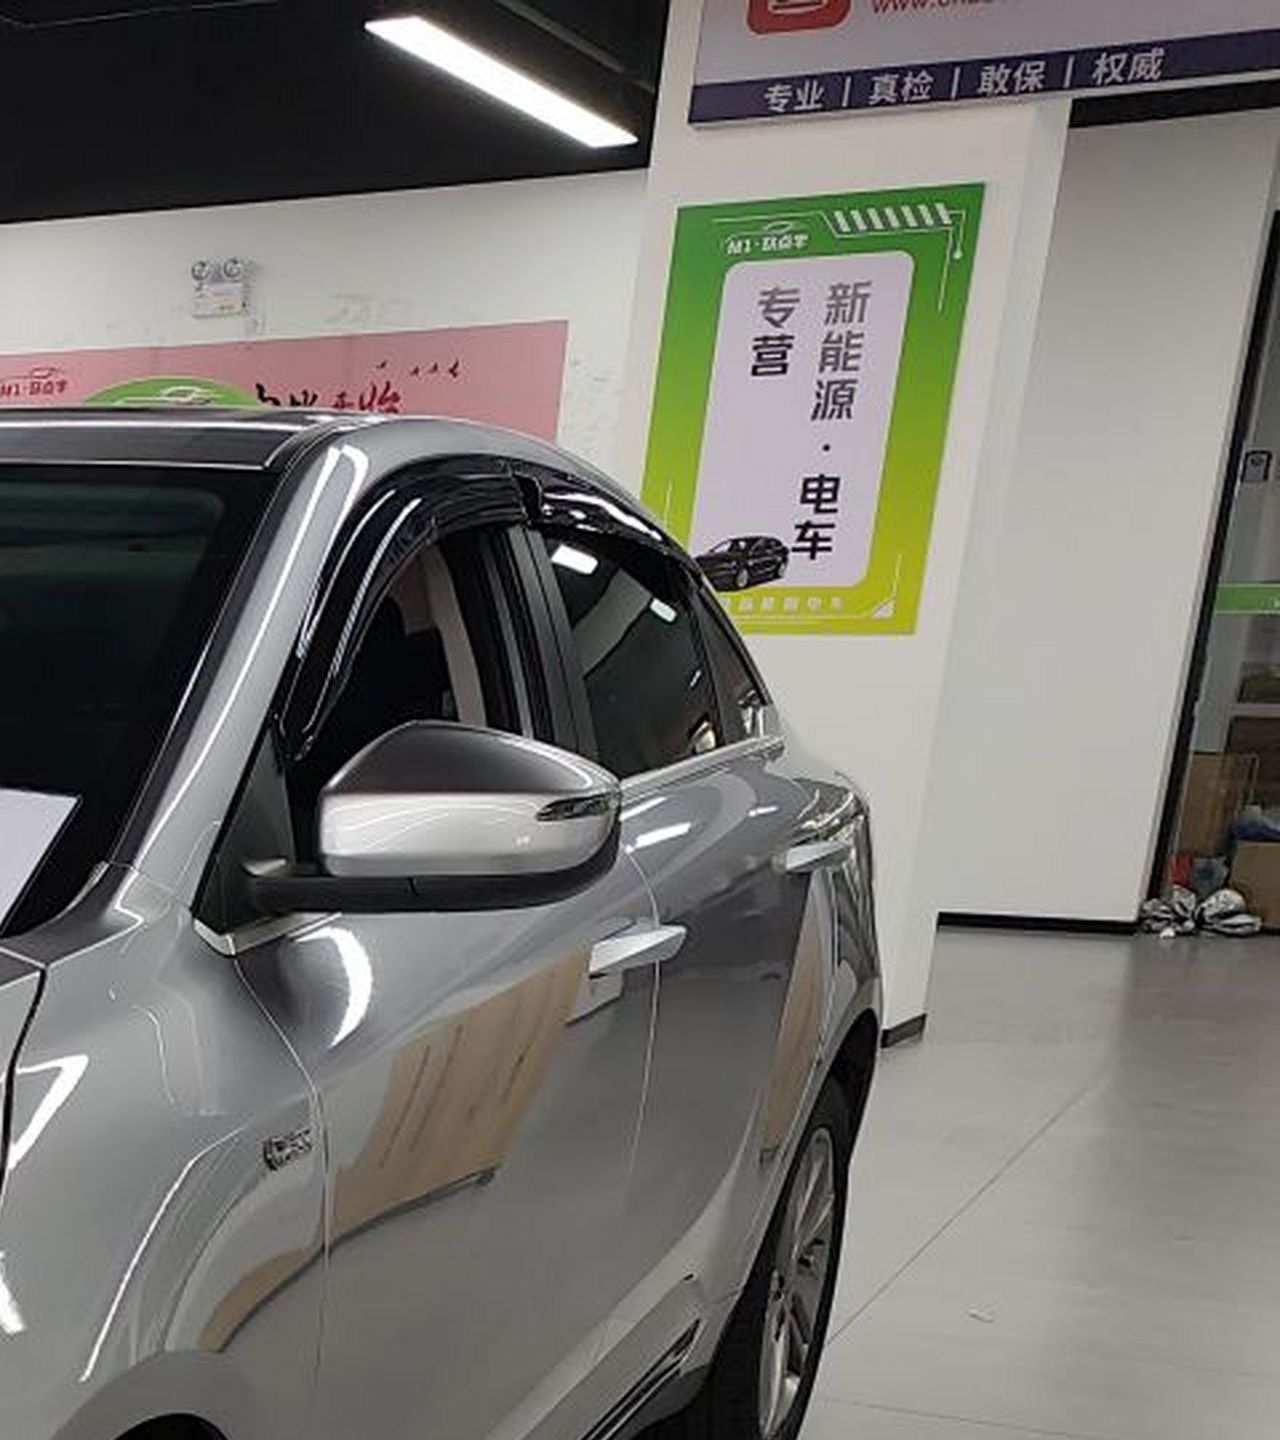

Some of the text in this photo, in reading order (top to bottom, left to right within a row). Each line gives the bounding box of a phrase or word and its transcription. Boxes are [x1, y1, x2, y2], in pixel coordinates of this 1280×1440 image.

[764, 47, 1165, 113] 专业 真检 敢保 权威
[751, 287, 801, 377] 专营
